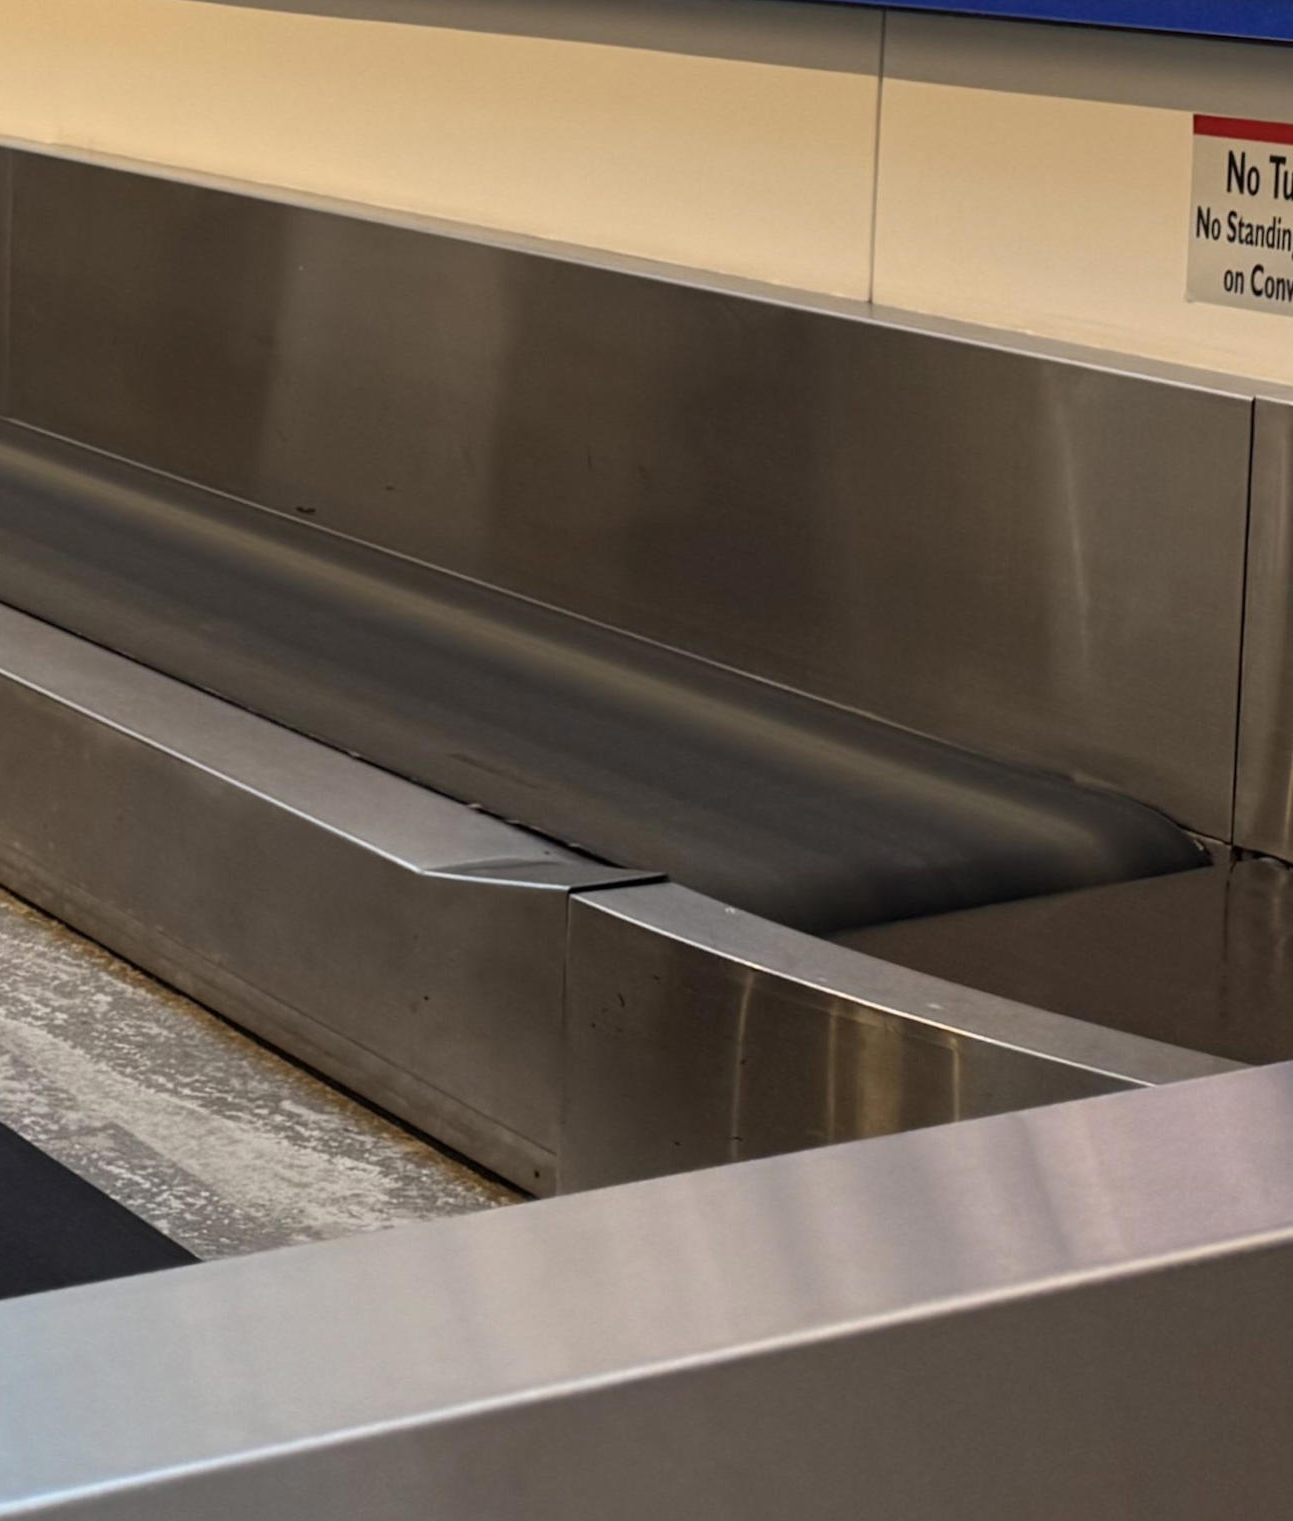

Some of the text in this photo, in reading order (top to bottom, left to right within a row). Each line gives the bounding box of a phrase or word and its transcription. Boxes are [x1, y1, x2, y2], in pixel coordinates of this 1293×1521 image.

[1227, 150, 1260, 196] No
[1196, 205, 1293, 261] No Standin
[1224, 269, 1244, 294] on
